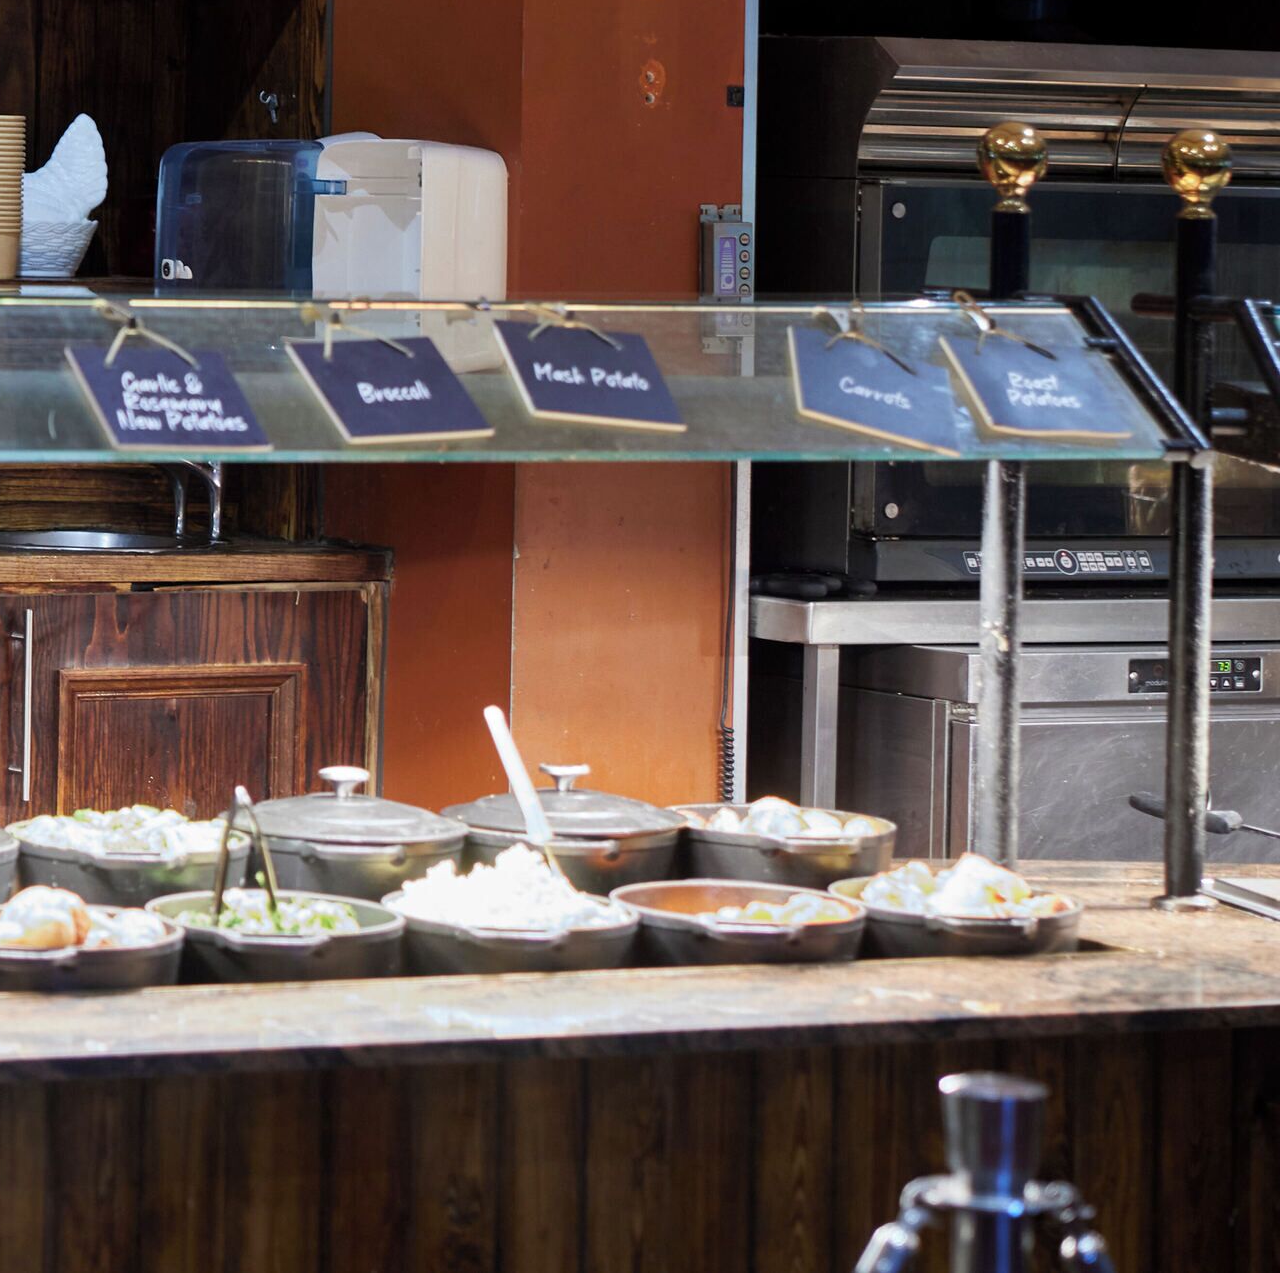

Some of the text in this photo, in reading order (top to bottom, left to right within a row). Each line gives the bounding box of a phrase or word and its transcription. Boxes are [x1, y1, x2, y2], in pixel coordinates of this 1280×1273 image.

[121, 371, 203, 394] Garlic &
[533, 362, 650, 391] Mash Potato
[1007, 372, 1058, 390] Roast
[123, 391, 223, 415] Rosemary
[357, 380, 431, 404] Broccoli
[839, 376, 912, 410] Carrots
[1006, 388, 1082, 408] Potatoes
[117, 409, 248, 431] New Potatoes
